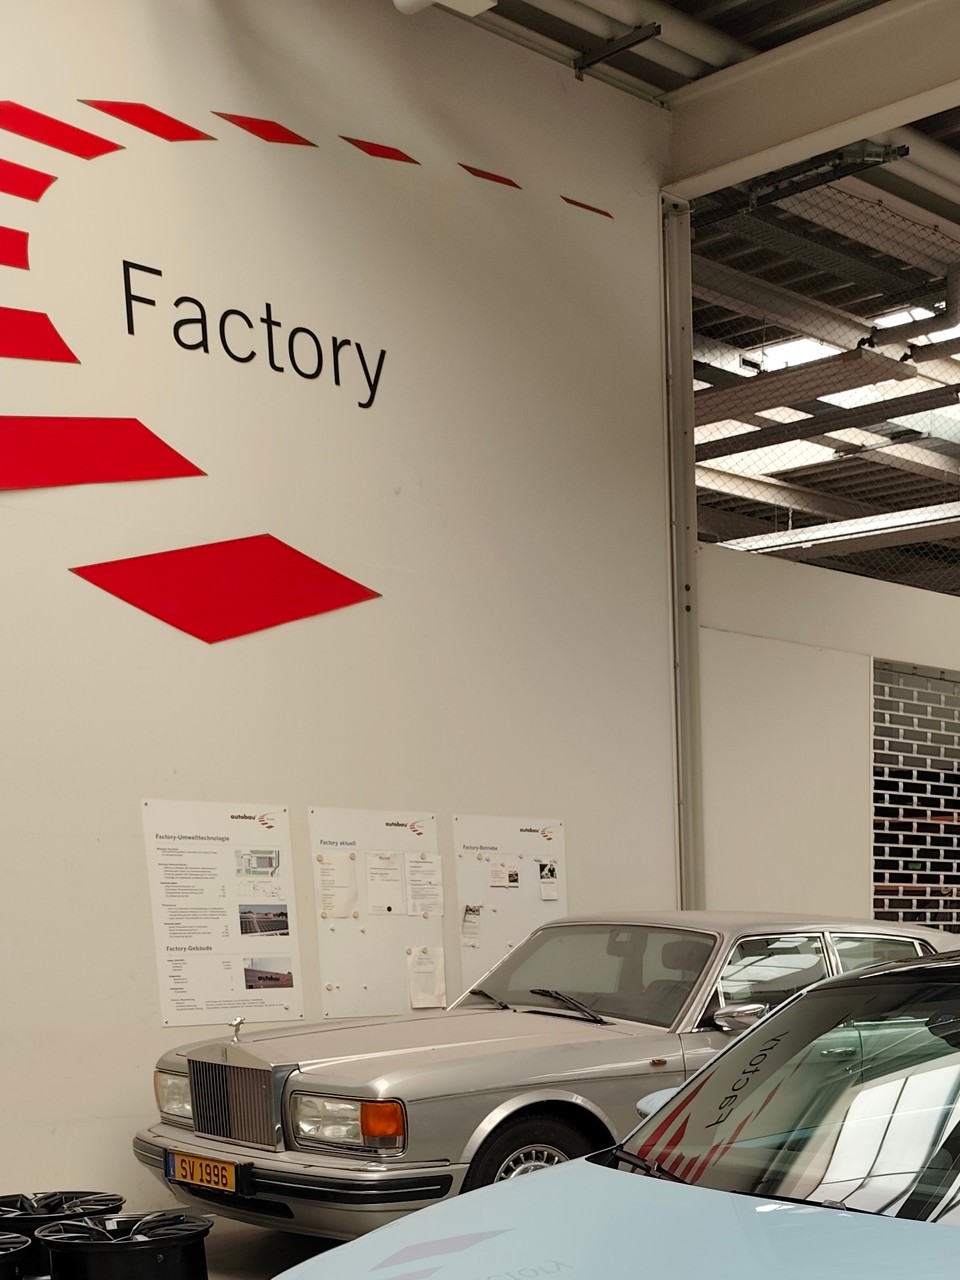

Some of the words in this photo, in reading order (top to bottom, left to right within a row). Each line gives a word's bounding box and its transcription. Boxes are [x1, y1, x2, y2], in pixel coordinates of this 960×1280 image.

[122, 259, 387, 409] Factory
[230, 813, 256, 821] autobau
[319, 839, 338, 847] Factory
[180, 1158, 195, 1181] SV
[199, 1162, 228, 1187] 1996
